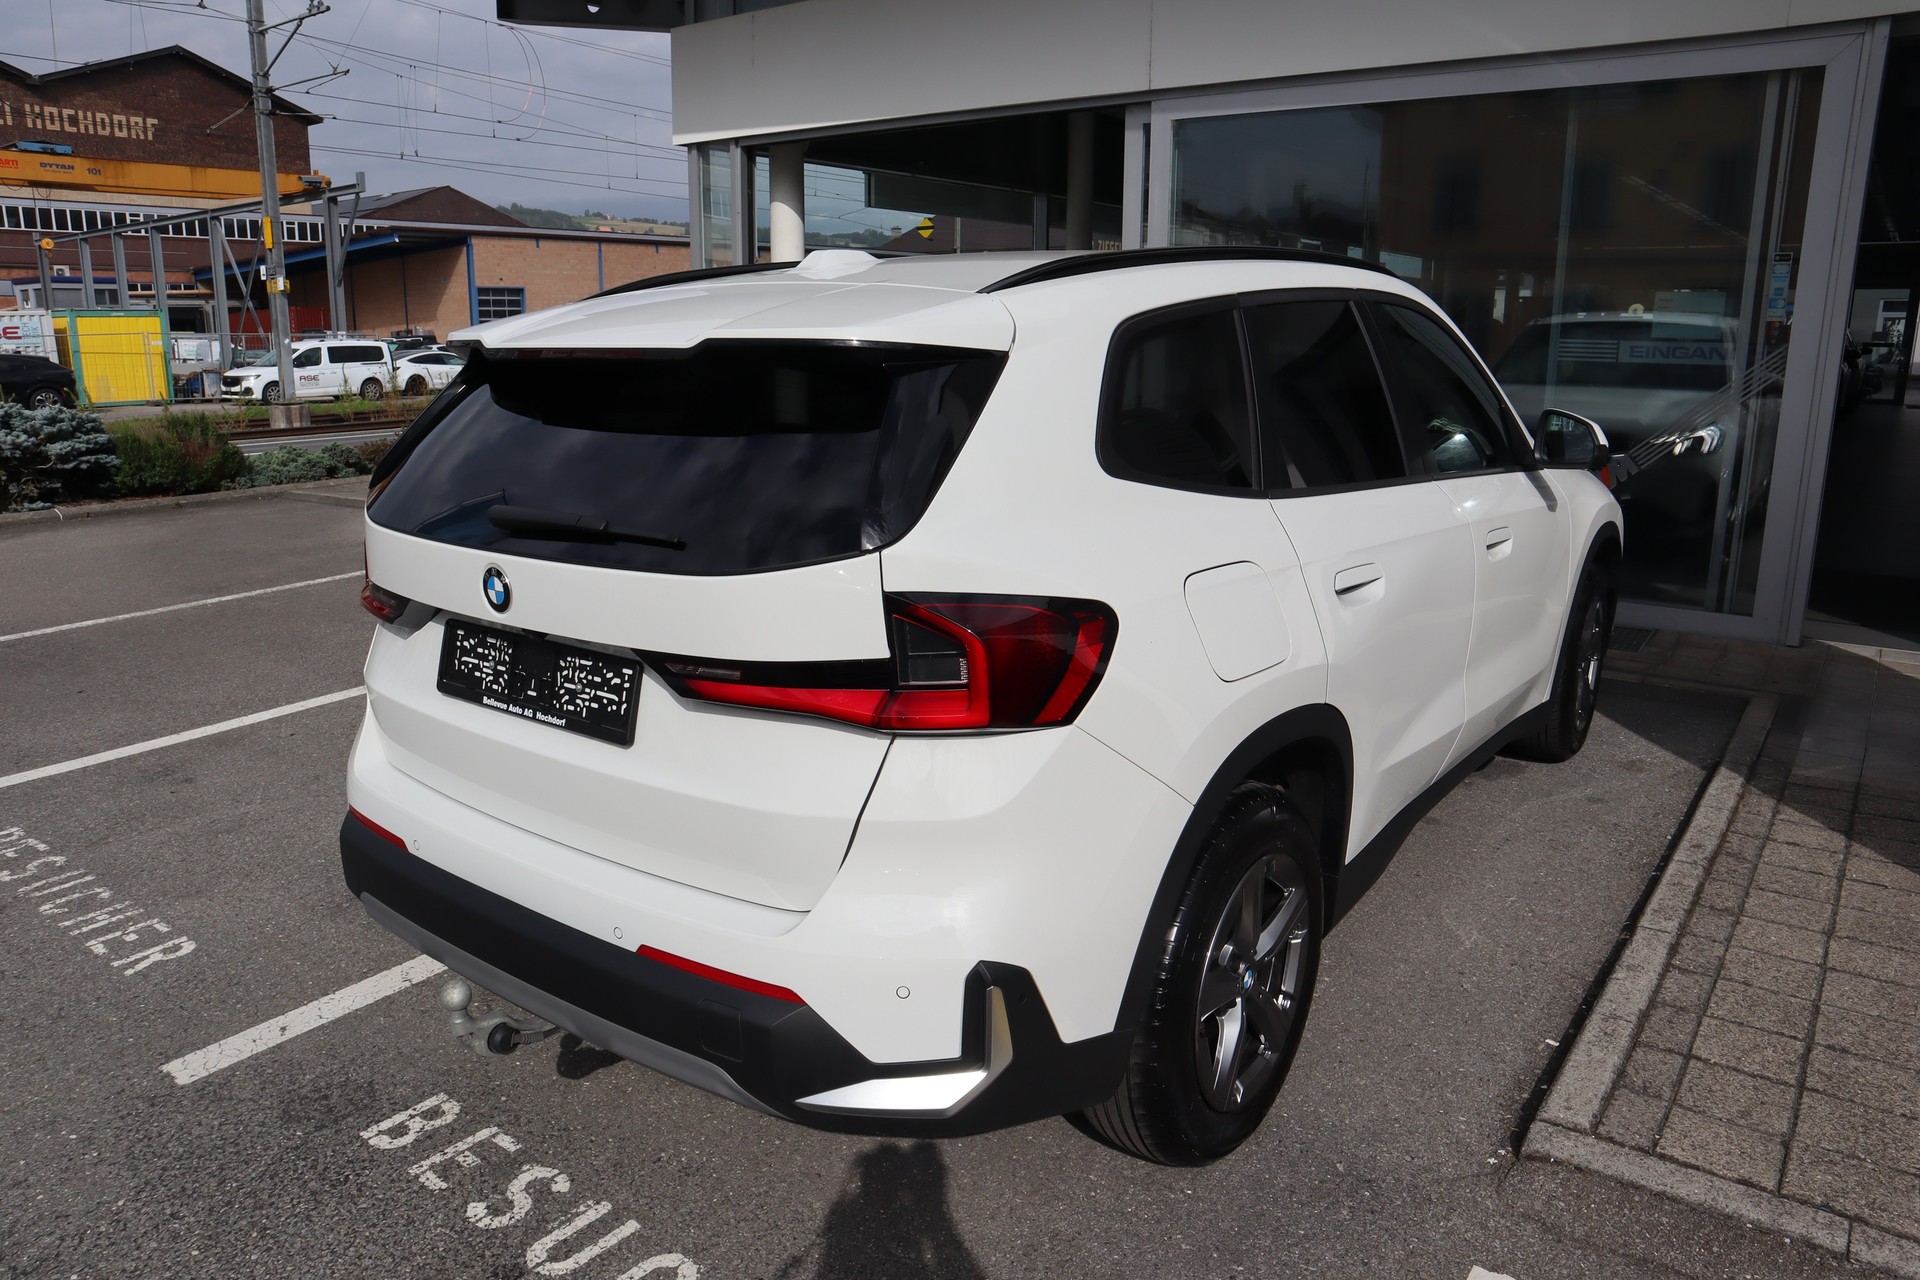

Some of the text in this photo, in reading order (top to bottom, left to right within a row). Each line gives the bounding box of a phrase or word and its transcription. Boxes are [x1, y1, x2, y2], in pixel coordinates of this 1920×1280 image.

[24, 103, 159, 141] HOCHDORF
[86, 167, 102, 176] 10t
[482, 696, 566, 727] Bellevue Auto AG Hochdorf
